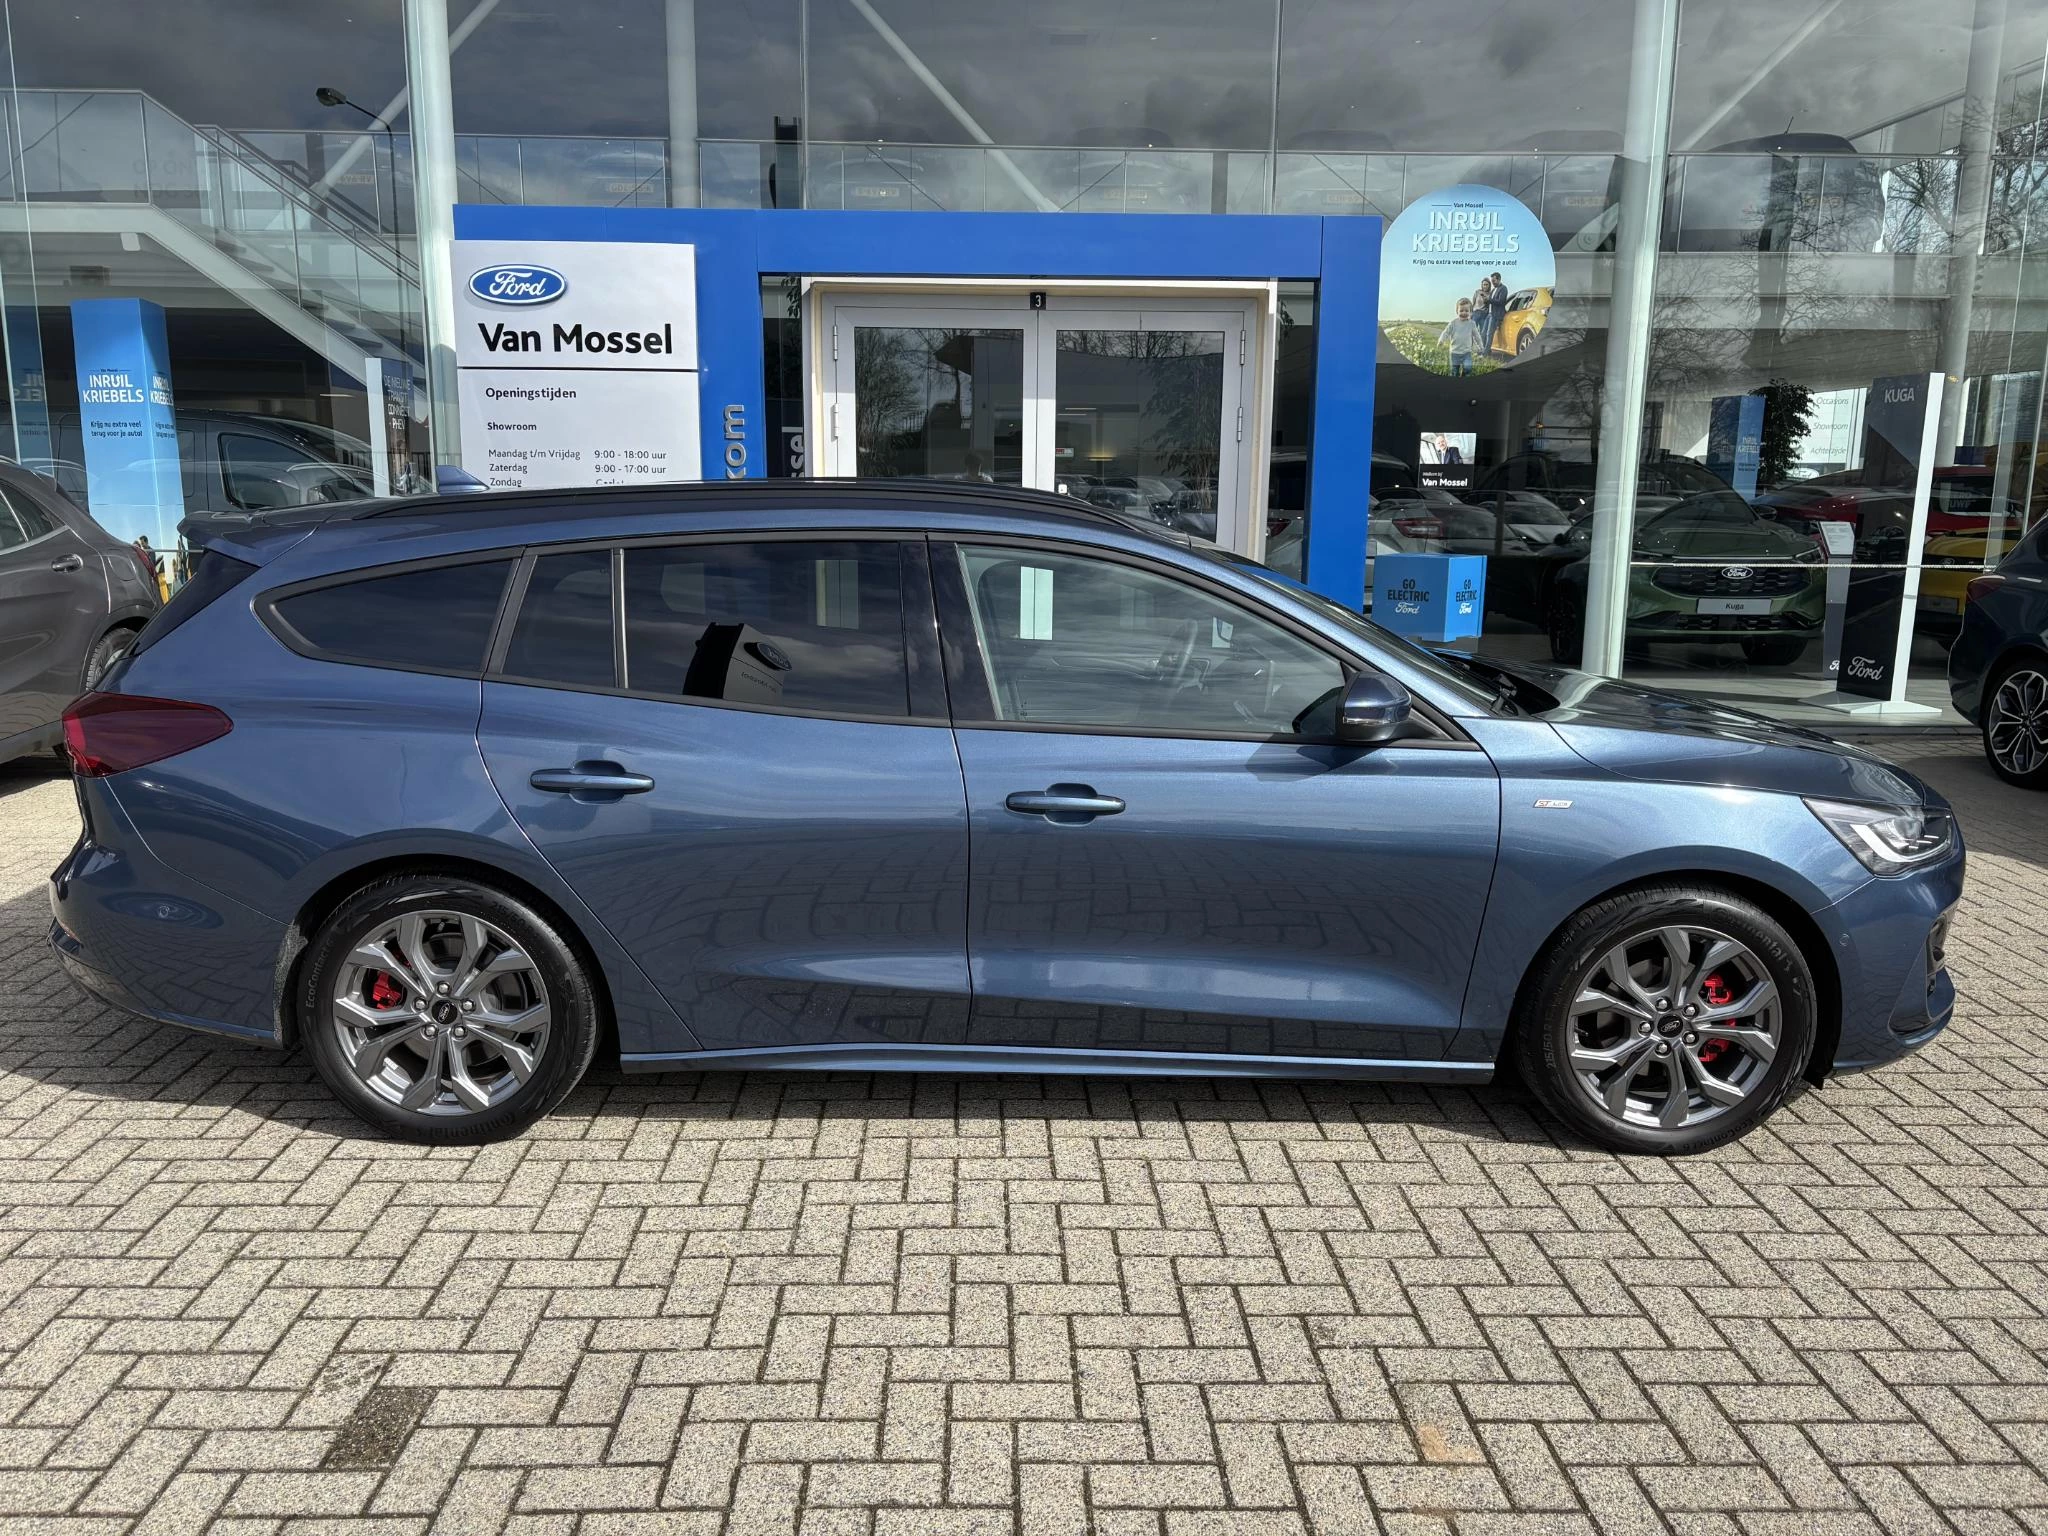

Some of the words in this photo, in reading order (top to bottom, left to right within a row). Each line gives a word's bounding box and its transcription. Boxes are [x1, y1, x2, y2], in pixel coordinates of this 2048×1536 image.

[1429, 211, 1505, 231] INRUIL
[1412, 233, 1520, 253] KRIEBELS
[1413, 259, 1427, 267] Krijg
[489, 270, 547, 296] Ford
[1035, 294, 1041, 307] 3
[477, 323, 542, 353] Van
[552, 323, 673, 354] Mossel
[89, 374, 133, 388] INRUIL
[83, 389, 145, 403] KRIEBELS
[485, 387, 577, 401] Openingstijden
[1884, 387, 1915, 403] KUGA
[90, 421, 104, 429] Krijg
[487, 421, 537, 431] Showroom
[91, 430, 106, 438] terug
[488, 449, 527, 460] Maandag
[529, 449, 546, 459] t/m
[548, 449, 580, 460] Vrijdag
[594, 450, 615, 459] 9:00
[624, 450, 649, 459] 18:00
[489, 464, 528, 474] Zaterdag
[594, 464, 616, 473] 9:00
[624, 465, 649, 473] 17:00
[651, 466, 667, 474] uur
[489, 478, 522, 487] Zondag
[1422, 478, 1438, 487] Van
[1439, 478, 1468, 487] Mossel
[1402, 579, 1416, 590] GO
[1463, 579, 1471, 590] GO
[1387, 589, 1430, 602] ELECTRIC
[1455, 589, 1477, 602] ELECTRIC
[1395, 601, 1420, 614] Ford
[1459, 602, 1473, 615] Ford
[1725, 602, 1744, 611] Kuga
[1847, 656, 1884, 681] Ford
